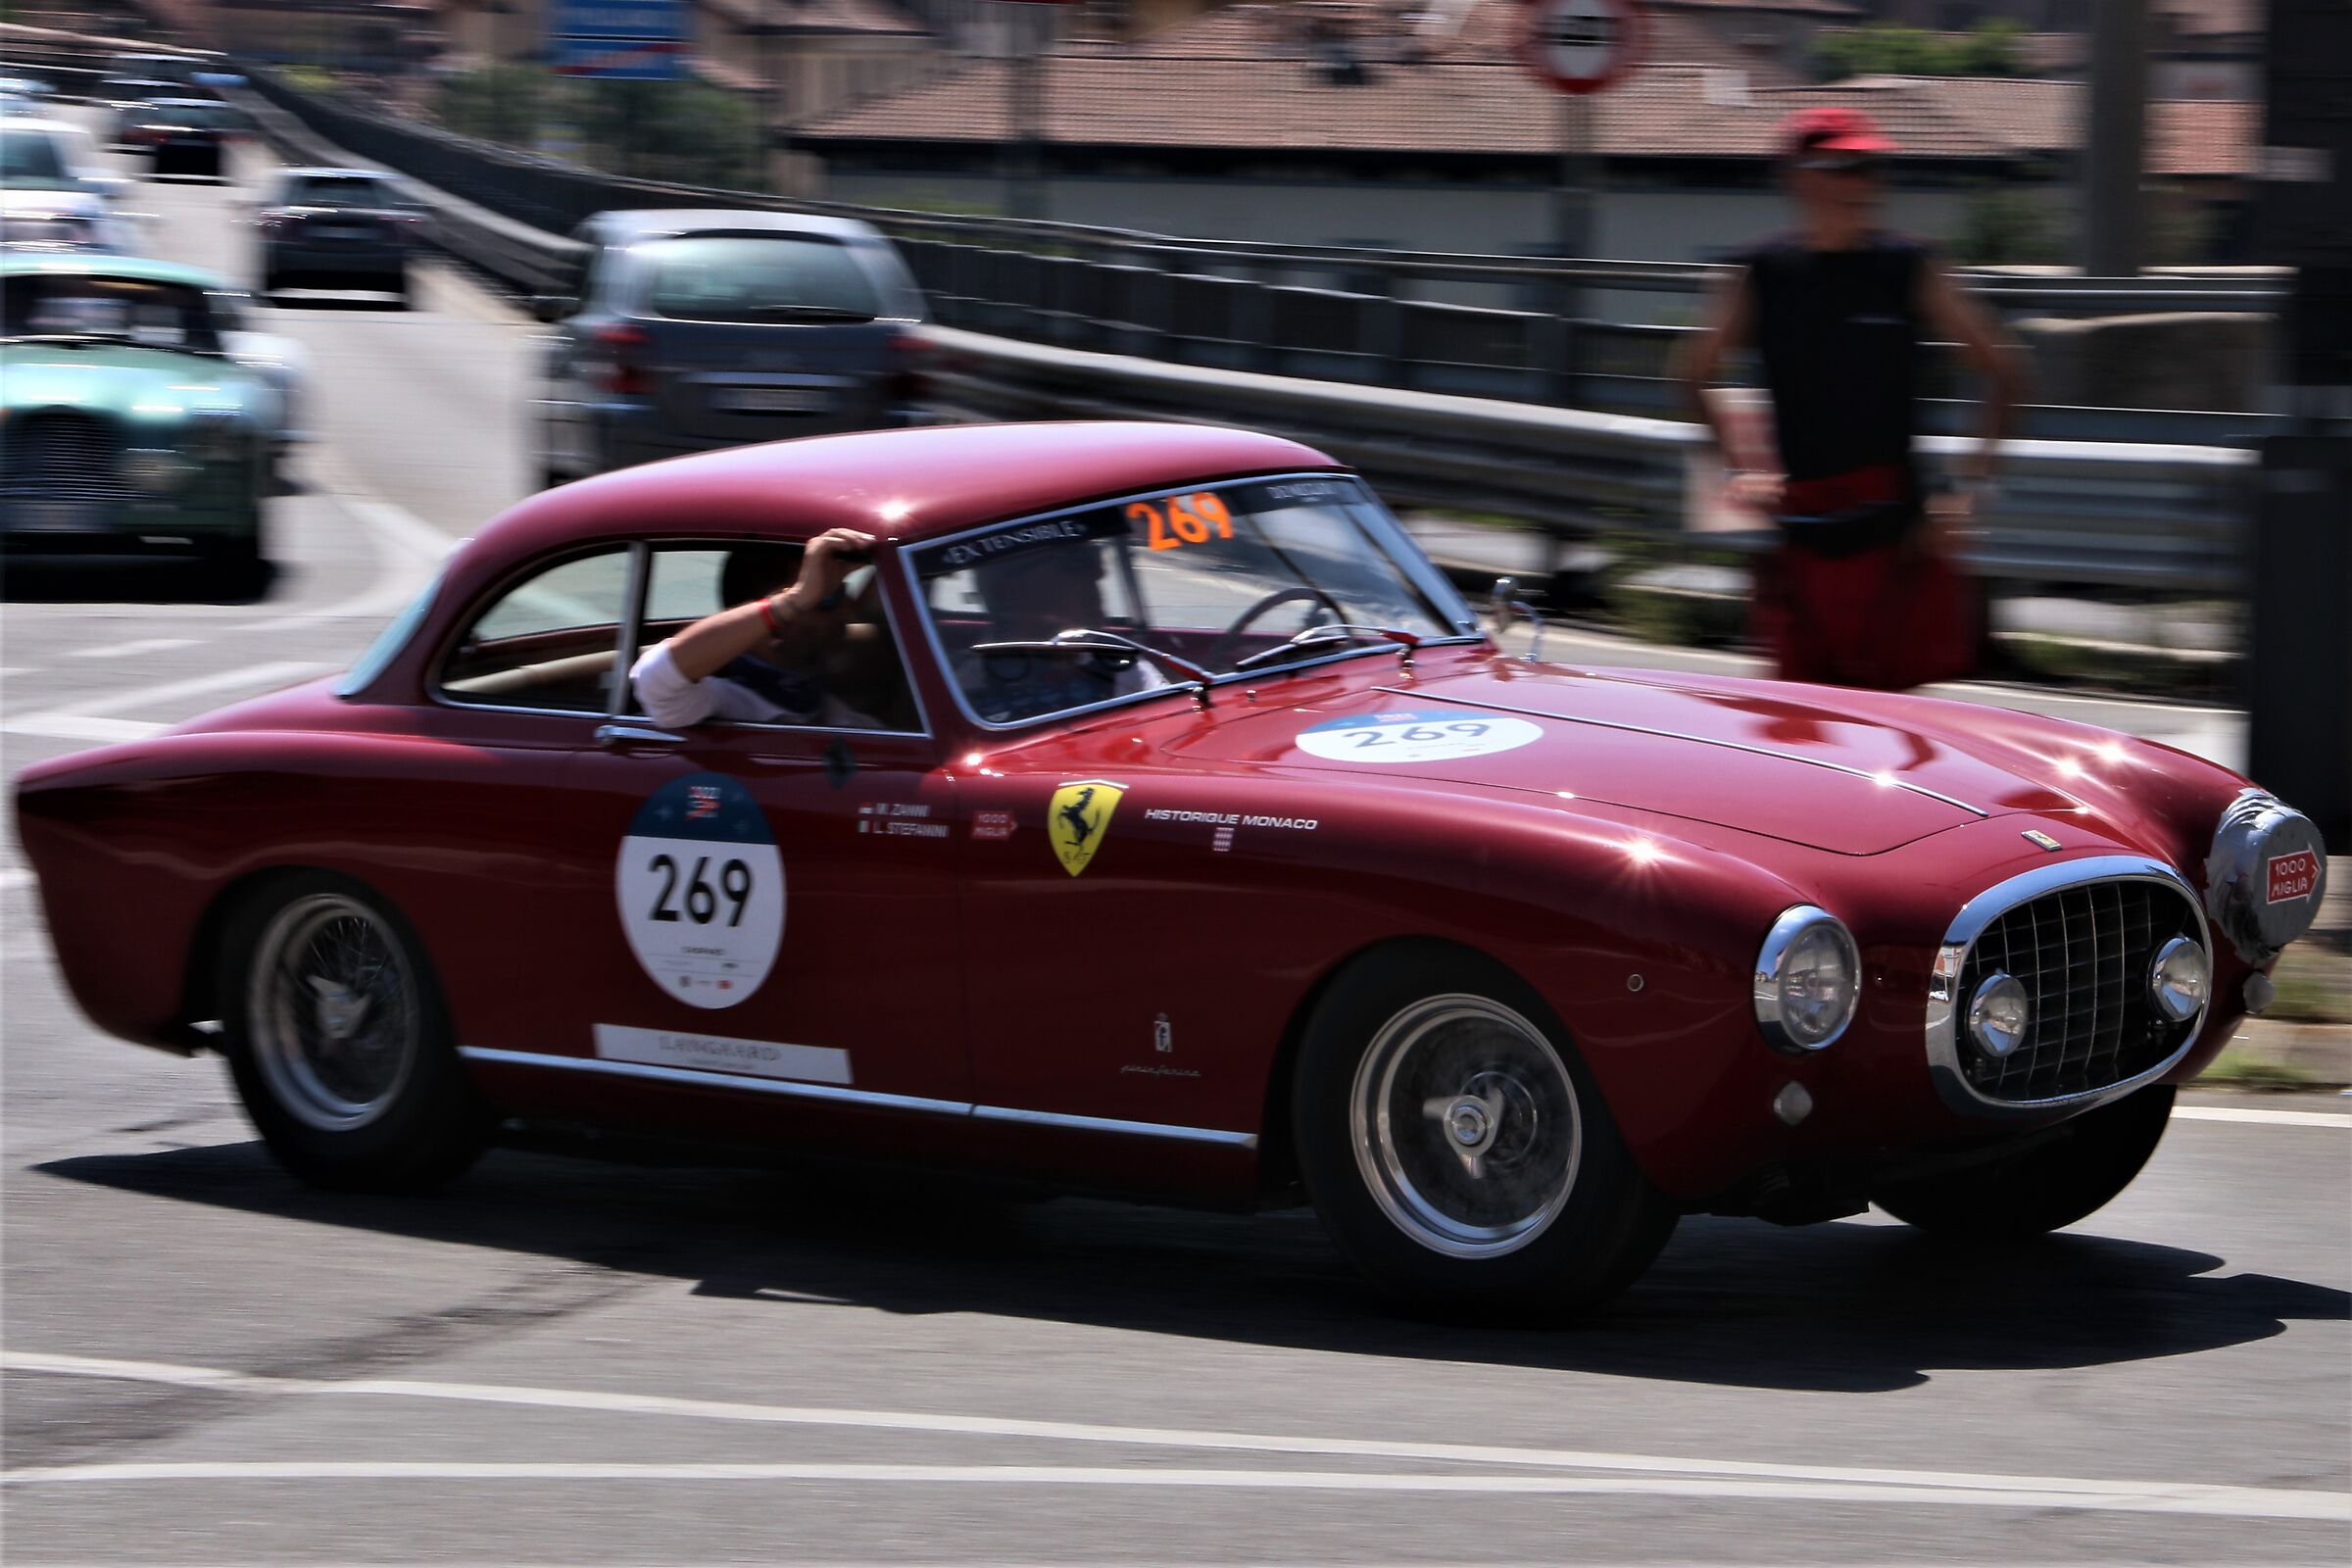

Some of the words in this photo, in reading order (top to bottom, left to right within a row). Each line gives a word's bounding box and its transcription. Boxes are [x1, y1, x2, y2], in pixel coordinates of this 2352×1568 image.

[1126, 491, 1235, 551] 269
[1344, 722, 1491, 748] 269
[1145, 808, 1239, 825] HISTORIQUE
[1242, 814, 1318, 830] MONACO
[2276, 858, 2306, 877] 1000
[648, 854, 754, 927] 269
[2271, 877, 2308, 898] MIGLIA
